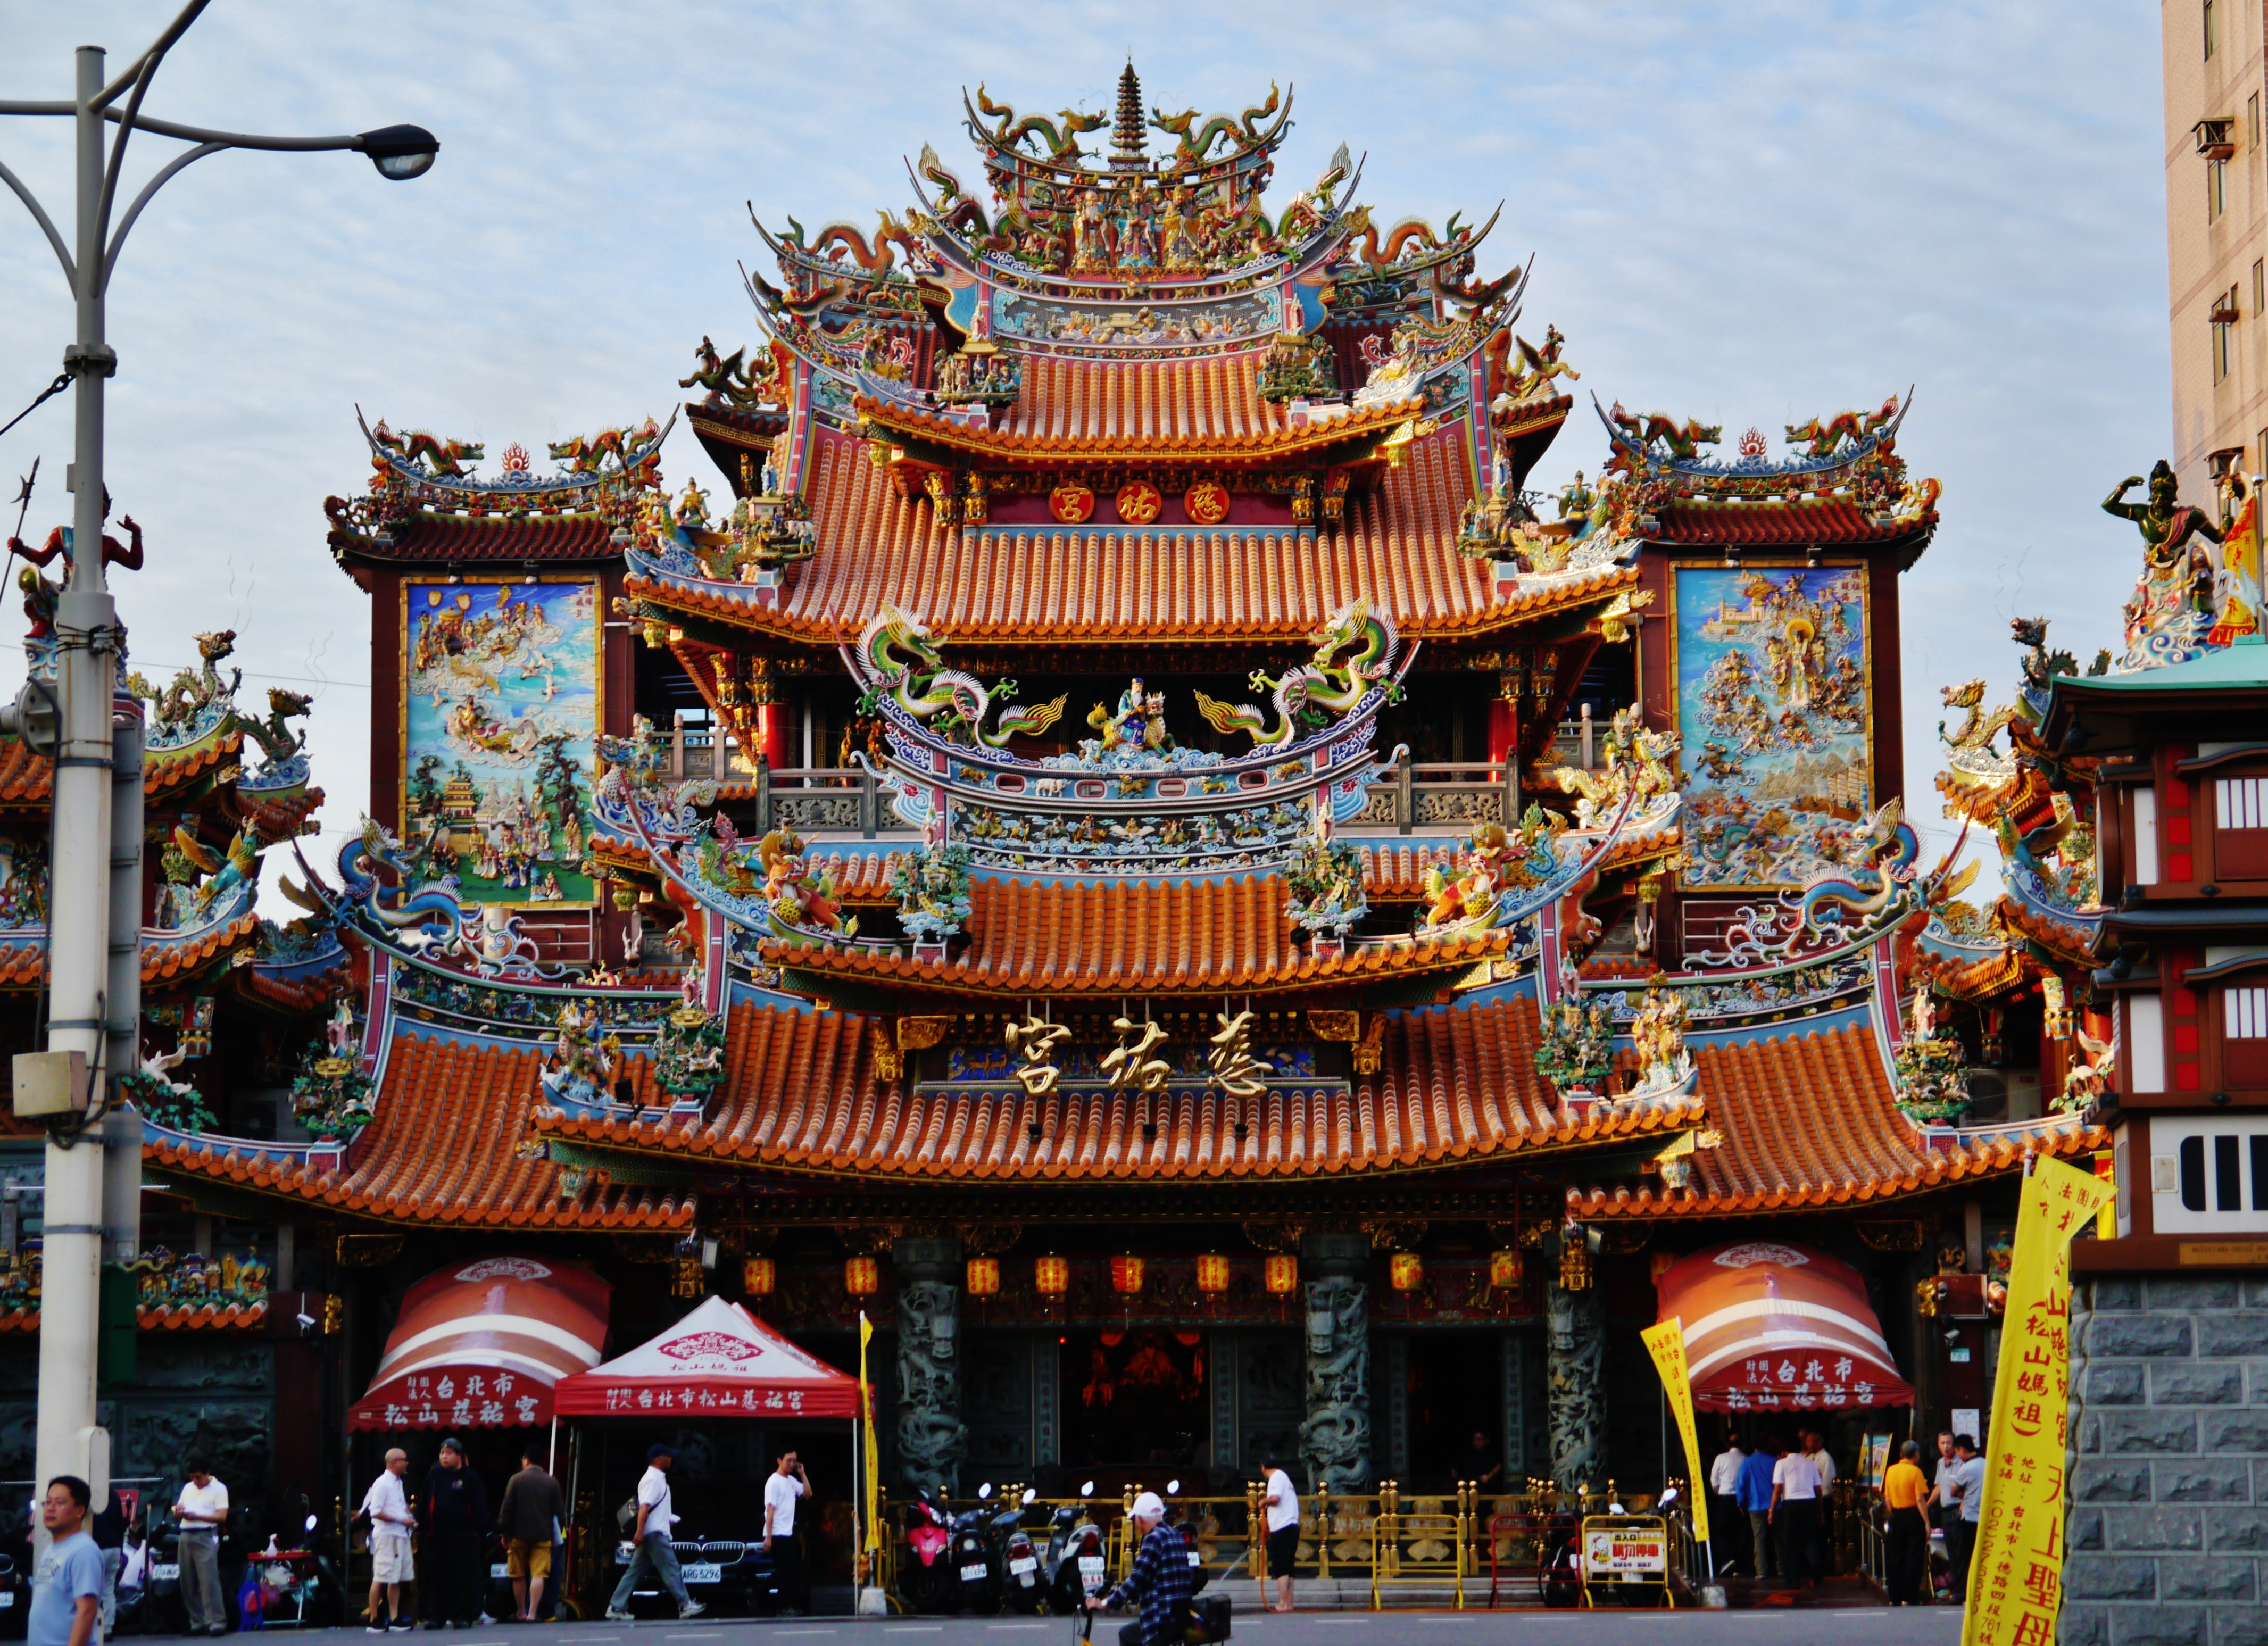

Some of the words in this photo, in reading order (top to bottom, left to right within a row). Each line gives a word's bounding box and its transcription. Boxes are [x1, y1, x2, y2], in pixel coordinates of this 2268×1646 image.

[1053, 480, 1223, 521] 慈祐宮
[1777, 1357, 1854, 1383] 台北市
[436, 1372, 515, 1398] 台北市
[1727, 1381, 1876, 1409] 松山慈祐宮
[384, 1395, 539, 1426] 松山慈祐宮
[638, 1387, 804, 1410] 台北市松山慈祐宮
[1612, 1543, 1659, 1560] 請勿停車
[683, 1569, 719, 1580] ARG-3296
